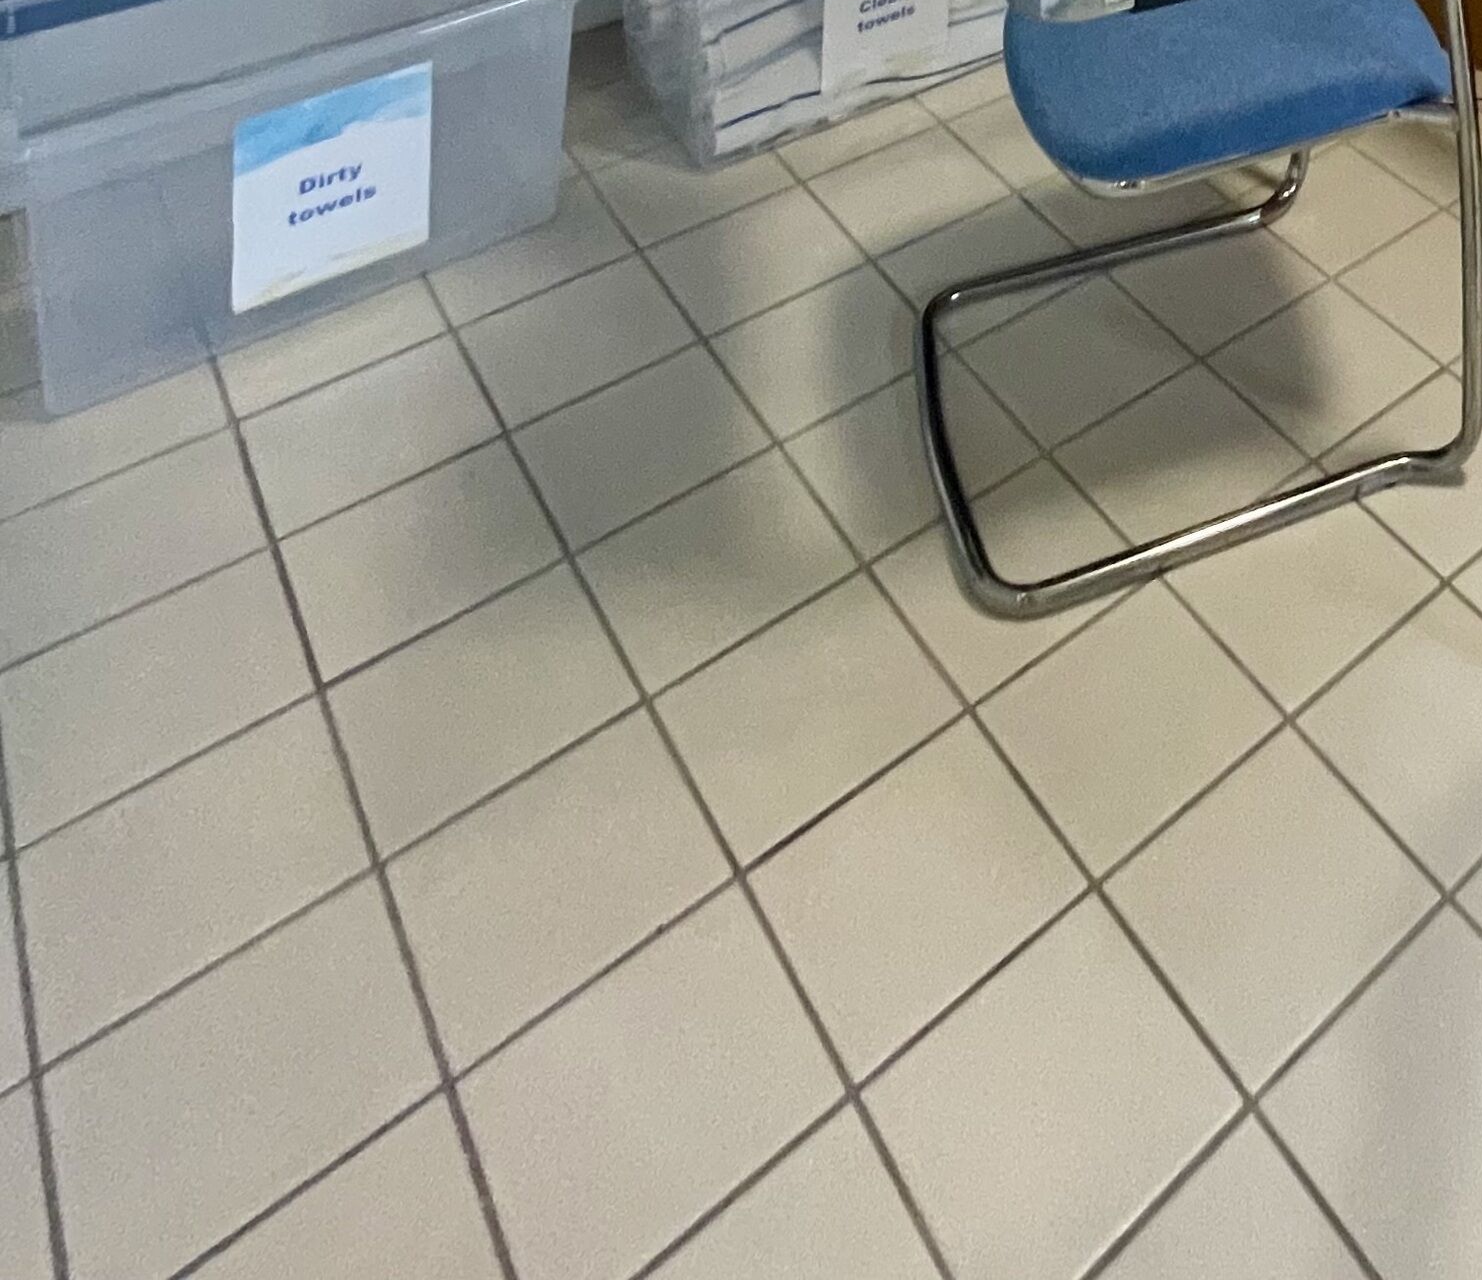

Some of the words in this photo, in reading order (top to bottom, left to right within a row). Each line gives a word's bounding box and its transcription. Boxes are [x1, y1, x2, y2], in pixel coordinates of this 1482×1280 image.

[857, 5, 916, 34] towels
[299, 161, 363, 195] Dirty
[288, 186, 377, 226] towels
